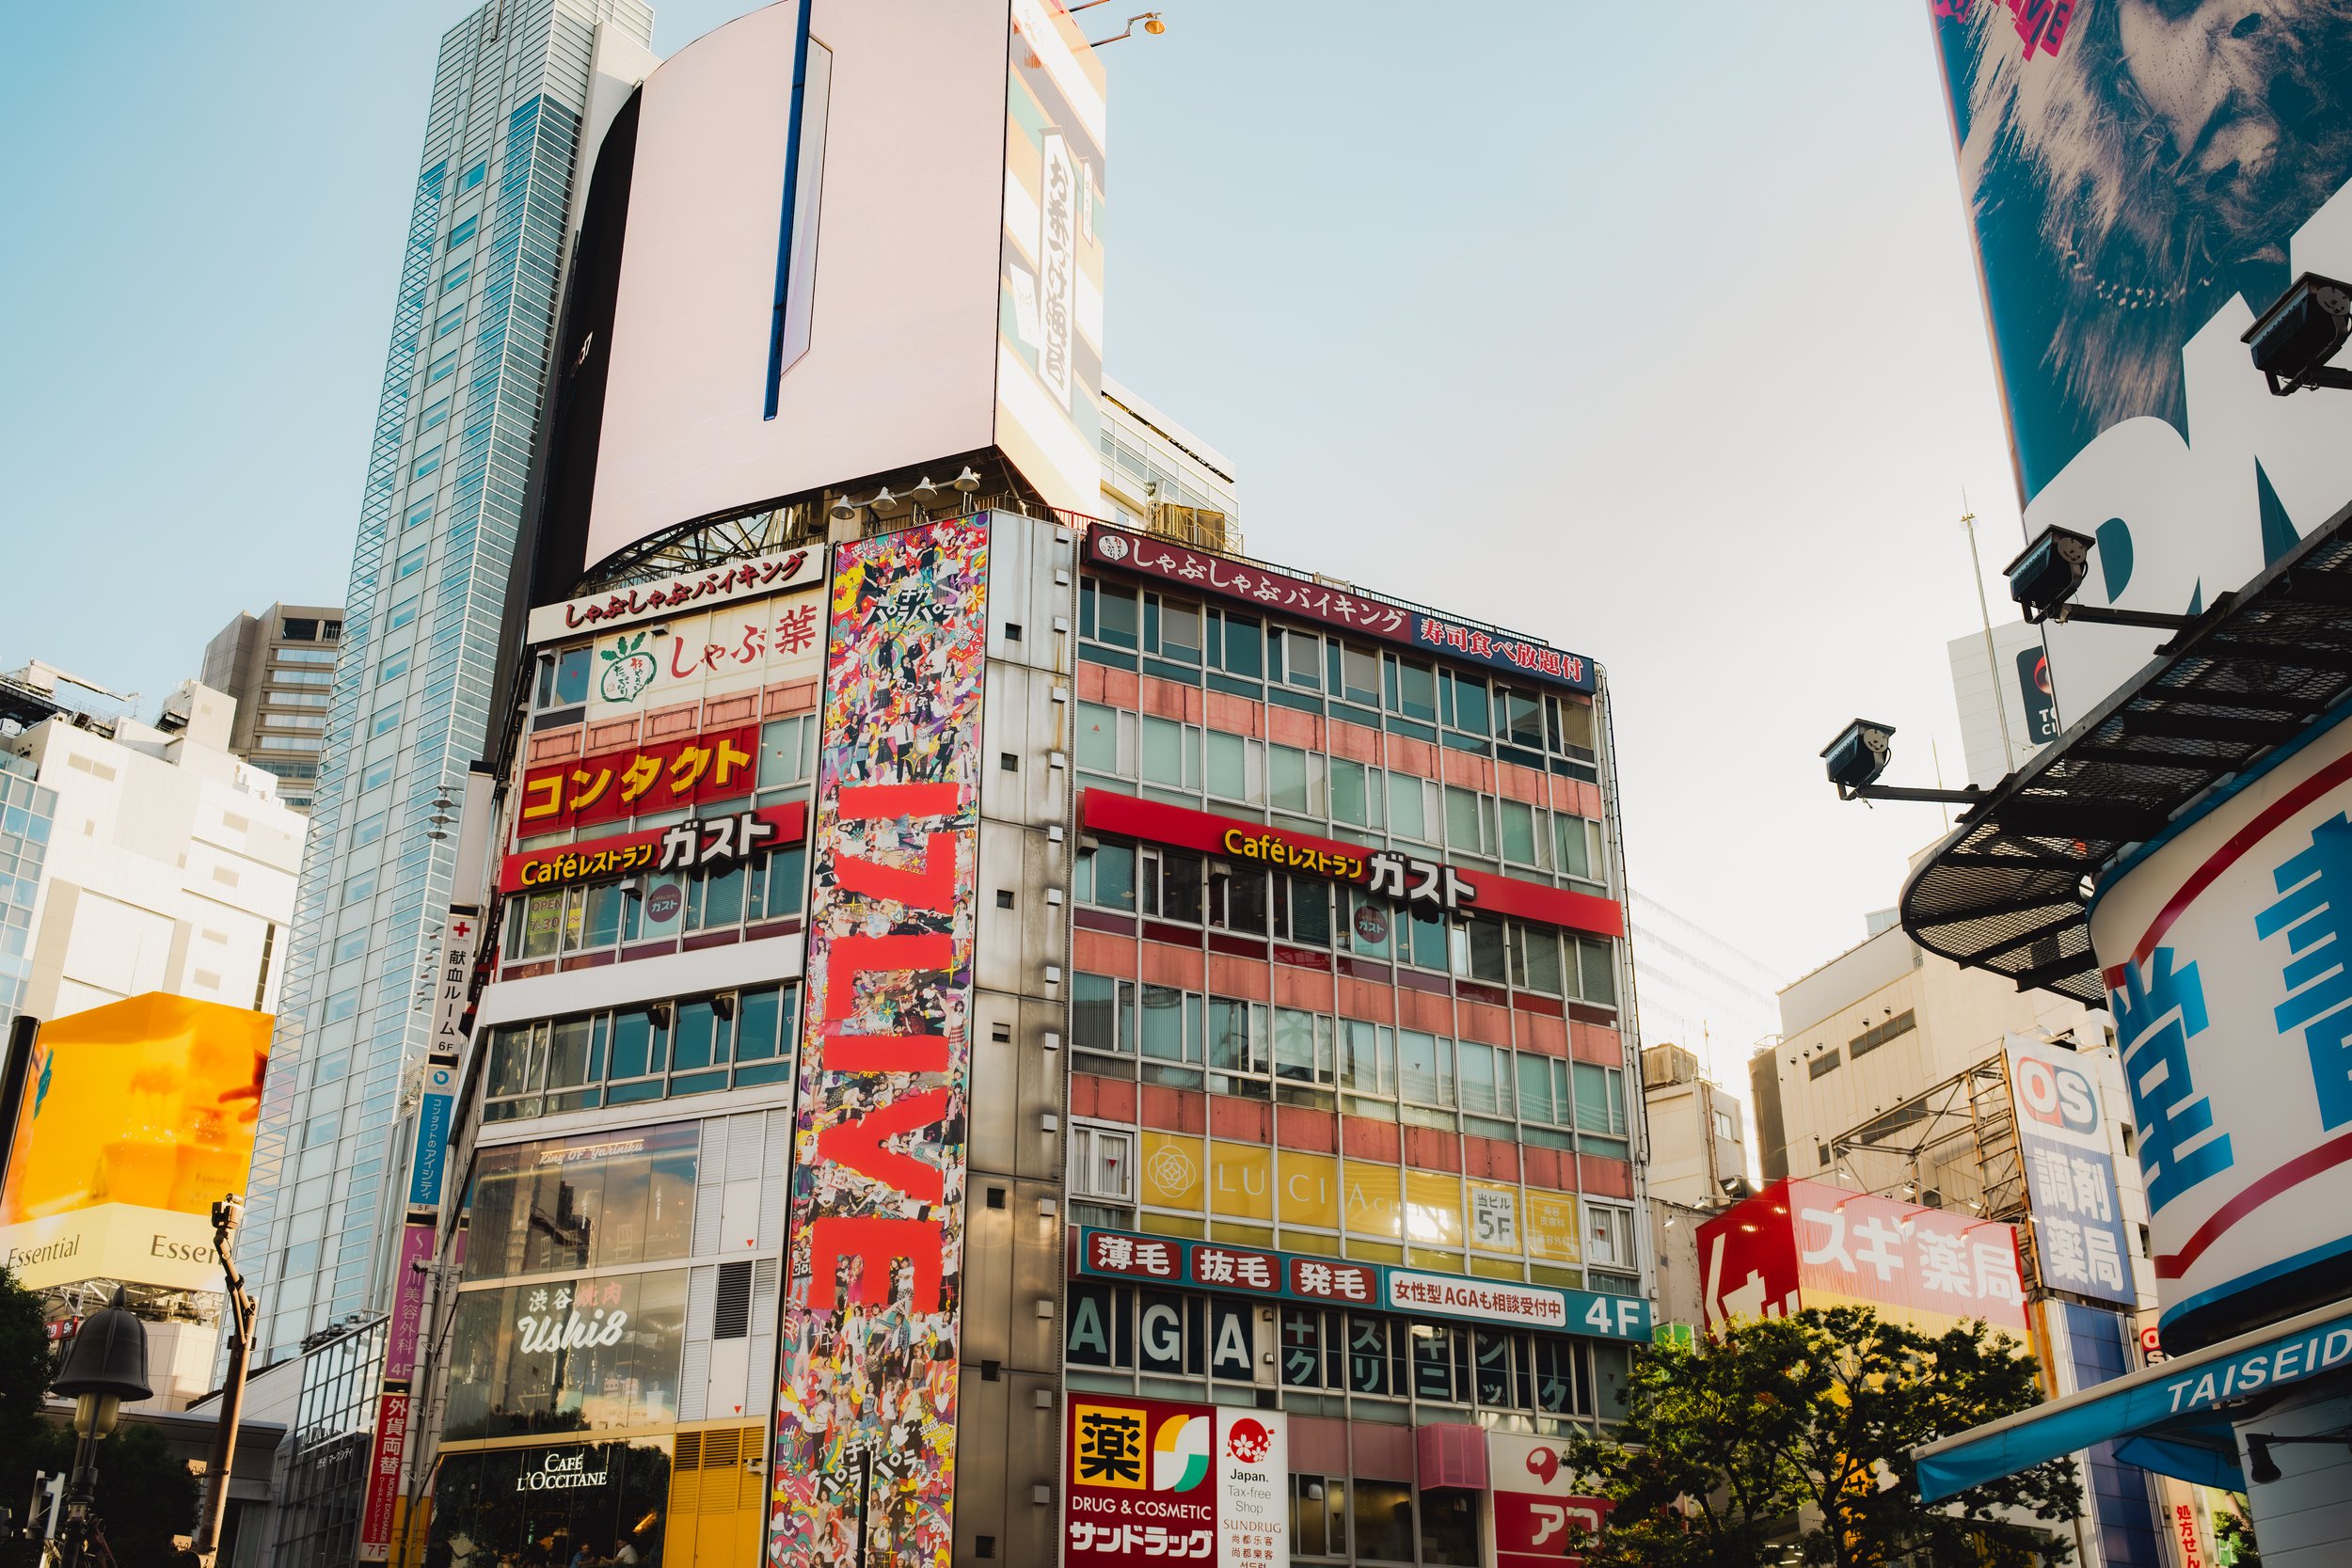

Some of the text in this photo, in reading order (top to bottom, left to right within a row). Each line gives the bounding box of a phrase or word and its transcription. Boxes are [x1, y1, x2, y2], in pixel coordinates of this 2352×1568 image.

[565, 550, 808, 628] しゃぶしゃぶバイキング
[1133, 538, 1407, 633] しゃぶしゃぶバイキング
[862, 603, 955, 627] パラパラ
[671, 604, 817, 678] しゃぶ葉
[1421, 617, 1584, 683] 寿司食べ放題付
[522, 737, 754, 817] コンタクト
[660, 813, 773, 871] ガスト
[1368, 849, 1476, 908] ガスト
[531, 898, 564, 912] OPEN
[651, 899, 677, 912] ガスト
[1359, 920, 1385, 934] ガスト
[439, 949, 467, 1037] 献血ルーム
[438, 1041, 454, 1052] 6F
[810, 783, 958, 1312] 17LIVE
[2020, 1068, 2095, 1125] OS
[421, 1098, 442, 1201] コンタクトのアイシティ
[1477, 1193, 1511, 1211] 当ビル
[2032, 1146, 2114, 1223] 調剤
[1477, 1211, 1511, 1243] 5F
[7, 1233, 81, 1269] Essential
[1095, 1235, 1171, 1276] 薄毛
[1198, 1248, 1272, 1289] 抜毛
[1801, 1207, 2027, 1307] スギ薬局
[2044, 1223, 2125, 1292] 薬局
[1296, 1261, 1369, 1301] 発毛
[396, 1254, 424, 1356] 品川美容外科
[1584, 1296, 1640, 1336] 4F
[516, 1308, 628, 1355] Ushi8
[1068, 1296, 1250, 1370] AGA
[390, 1364, 413, 1377] 4F
[380, 1398, 407, 1476] 外貨両替
[1079, 1412, 1145, 1482] 薬
[1228, 1484, 1272, 1500] Tax-free
[1230, 1467, 1269, 1483] Japan.
[1073, 1497, 1212, 1521] DRUG & COSMETIC
[1223, 1518, 1281, 1534] SUNDRUG
[1235, 1499, 1263, 1515] Shop
[1530, 1503, 1607, 1548] アコ
[368, 1544, 388, 1557] 7F
[1069, 1522, 1215, 1559] サンドラッグ
[1231, 1534, 1273, 1546] 尚都乐客
[2176, 1505, 2201, 1568] 処方せん
